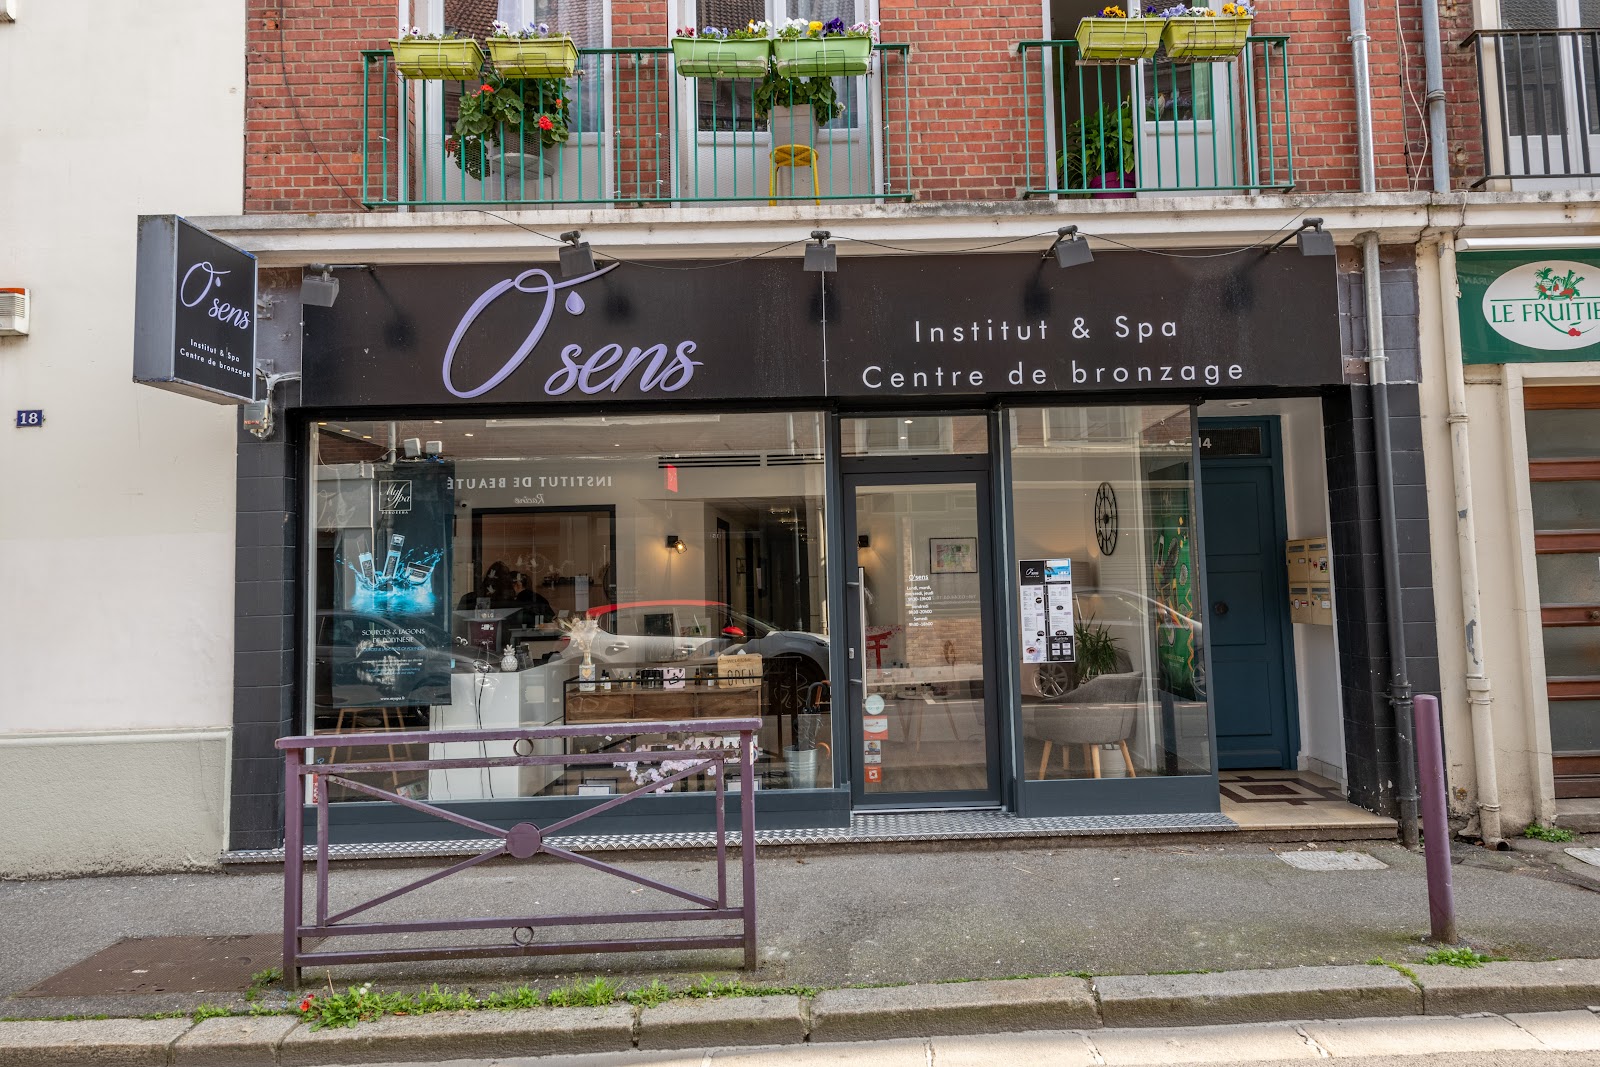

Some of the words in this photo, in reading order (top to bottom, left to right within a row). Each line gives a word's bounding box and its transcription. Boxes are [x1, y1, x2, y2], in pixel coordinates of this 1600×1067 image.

[1491, 304, 1515, 323] LE
[915, 318, 1048, 343] Institut
[1071, 316, 1091, 340] &
[1114, 315, 1178, 344] Spa
[190, 338, 217, 355] Institut
[219, 349, 225, 358] &
[227, 351, 240, 363] Spa
[180, 347, 205, 363] Centre
[207, 357, 217, 367] de
[219, 360, 251, 378] bronzage
[862, 365, 984, 389] Centre
[1008, 361, 1047, 385] de
[1071, 360, 1243, 386] bronzage
[20, 412, 39, 425] 18
[1198, 437, 1212, 449] 14
[727, 668, 755, 686] OPEN
